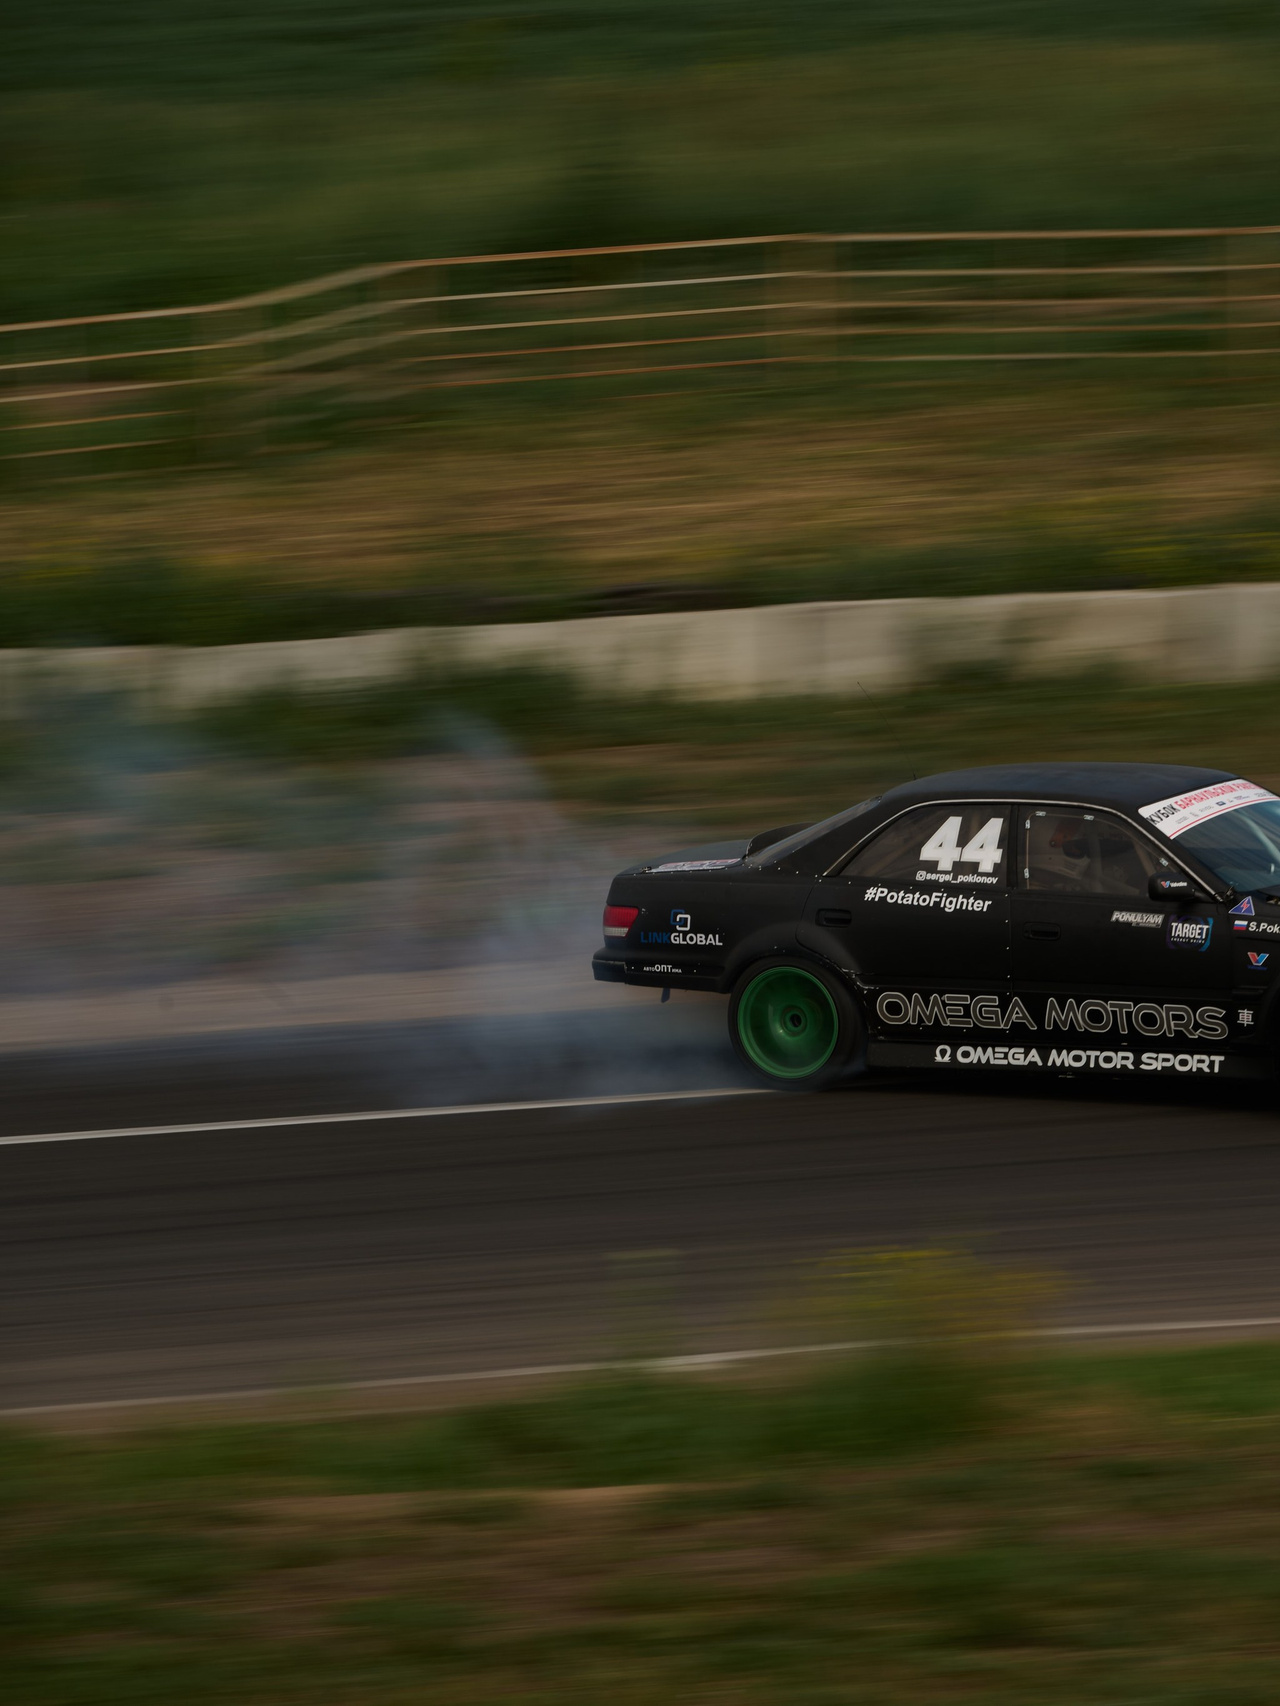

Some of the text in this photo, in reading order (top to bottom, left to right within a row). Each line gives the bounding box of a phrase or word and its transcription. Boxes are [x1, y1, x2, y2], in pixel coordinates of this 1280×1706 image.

[1146, 803, 1181, 825] КУБОК
[919, 816, 1004, 873] 44
[864, 886, 992, 912] #PotatoFighter
[1110, 910, 1166, 924] PONULYAM
[640, 931, 723, 946] LINKGLOBAL
[1171, 922, 1210, 939] TARGET
[876, 991, 1229, 1040] OMEGA MOTORS
[956, 1045, 1043, 1066] OMEGA
[1047, 1048, 1135, 1070] MOTOR
[1139, 1052, 1225, 1073] SPORT
